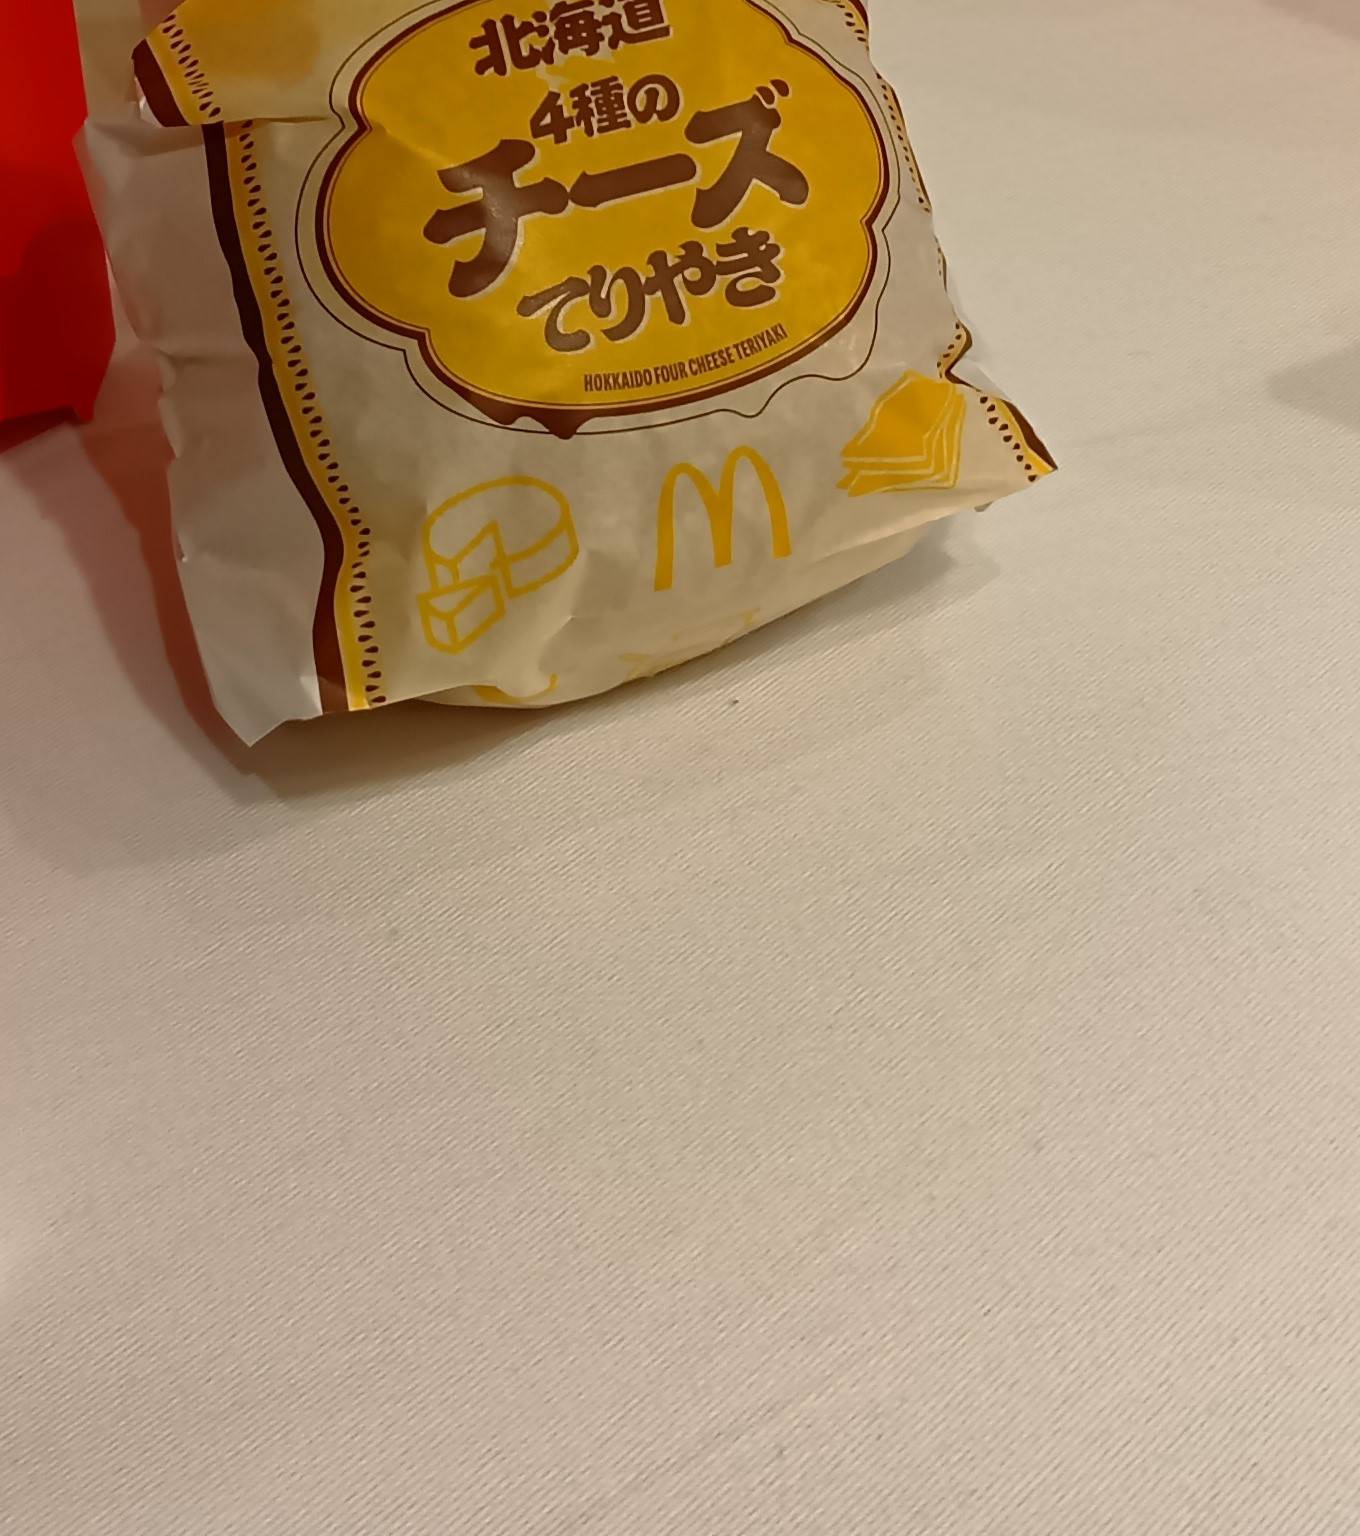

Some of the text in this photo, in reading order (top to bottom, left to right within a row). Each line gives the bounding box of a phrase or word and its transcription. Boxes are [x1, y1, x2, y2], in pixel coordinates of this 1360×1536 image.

[530, 74, 681, 144] 4種の
[423, 79, 810, 298] チーズ
[517, 227, 784, 353] てりやき
[584, 323, 789, 392] HOKKAIDO FOUR CHEESE TERIYAKI
[654, 445, 791, 591] M
